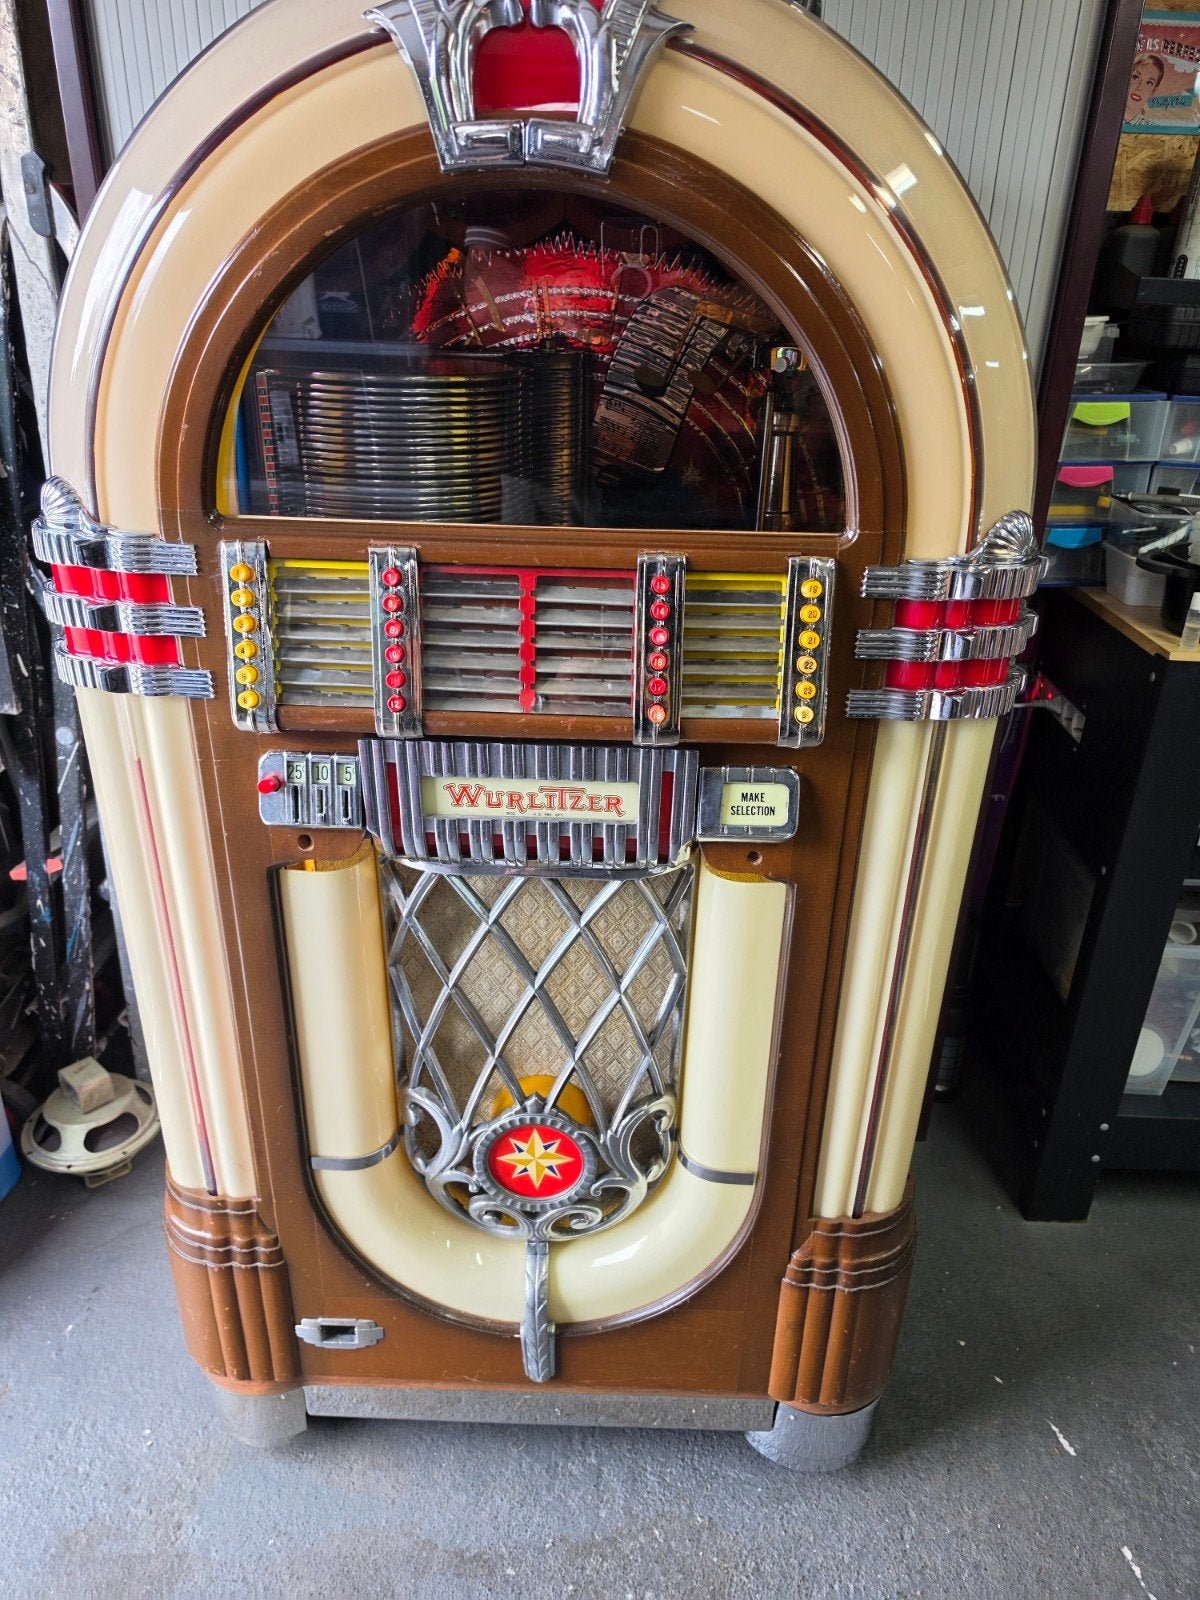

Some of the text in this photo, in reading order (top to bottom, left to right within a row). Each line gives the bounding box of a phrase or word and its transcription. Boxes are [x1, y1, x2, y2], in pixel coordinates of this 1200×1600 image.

[809, 585, 819, 594] 19
[656, 607, 665, 616] 14
[808, 610, 818, 619] 20
[808, 636, 817, 645] 21
[389, 650, 398, 660] 10
[804, 661, 814, 670] 22
[653, 683, 663, 692] 17
[803, 686, 813, 695] 23
[390, 700, 400, 709] 12
[741, 792, 766, 803] MAKE
[730, 805, 776, 817] SELECTION
